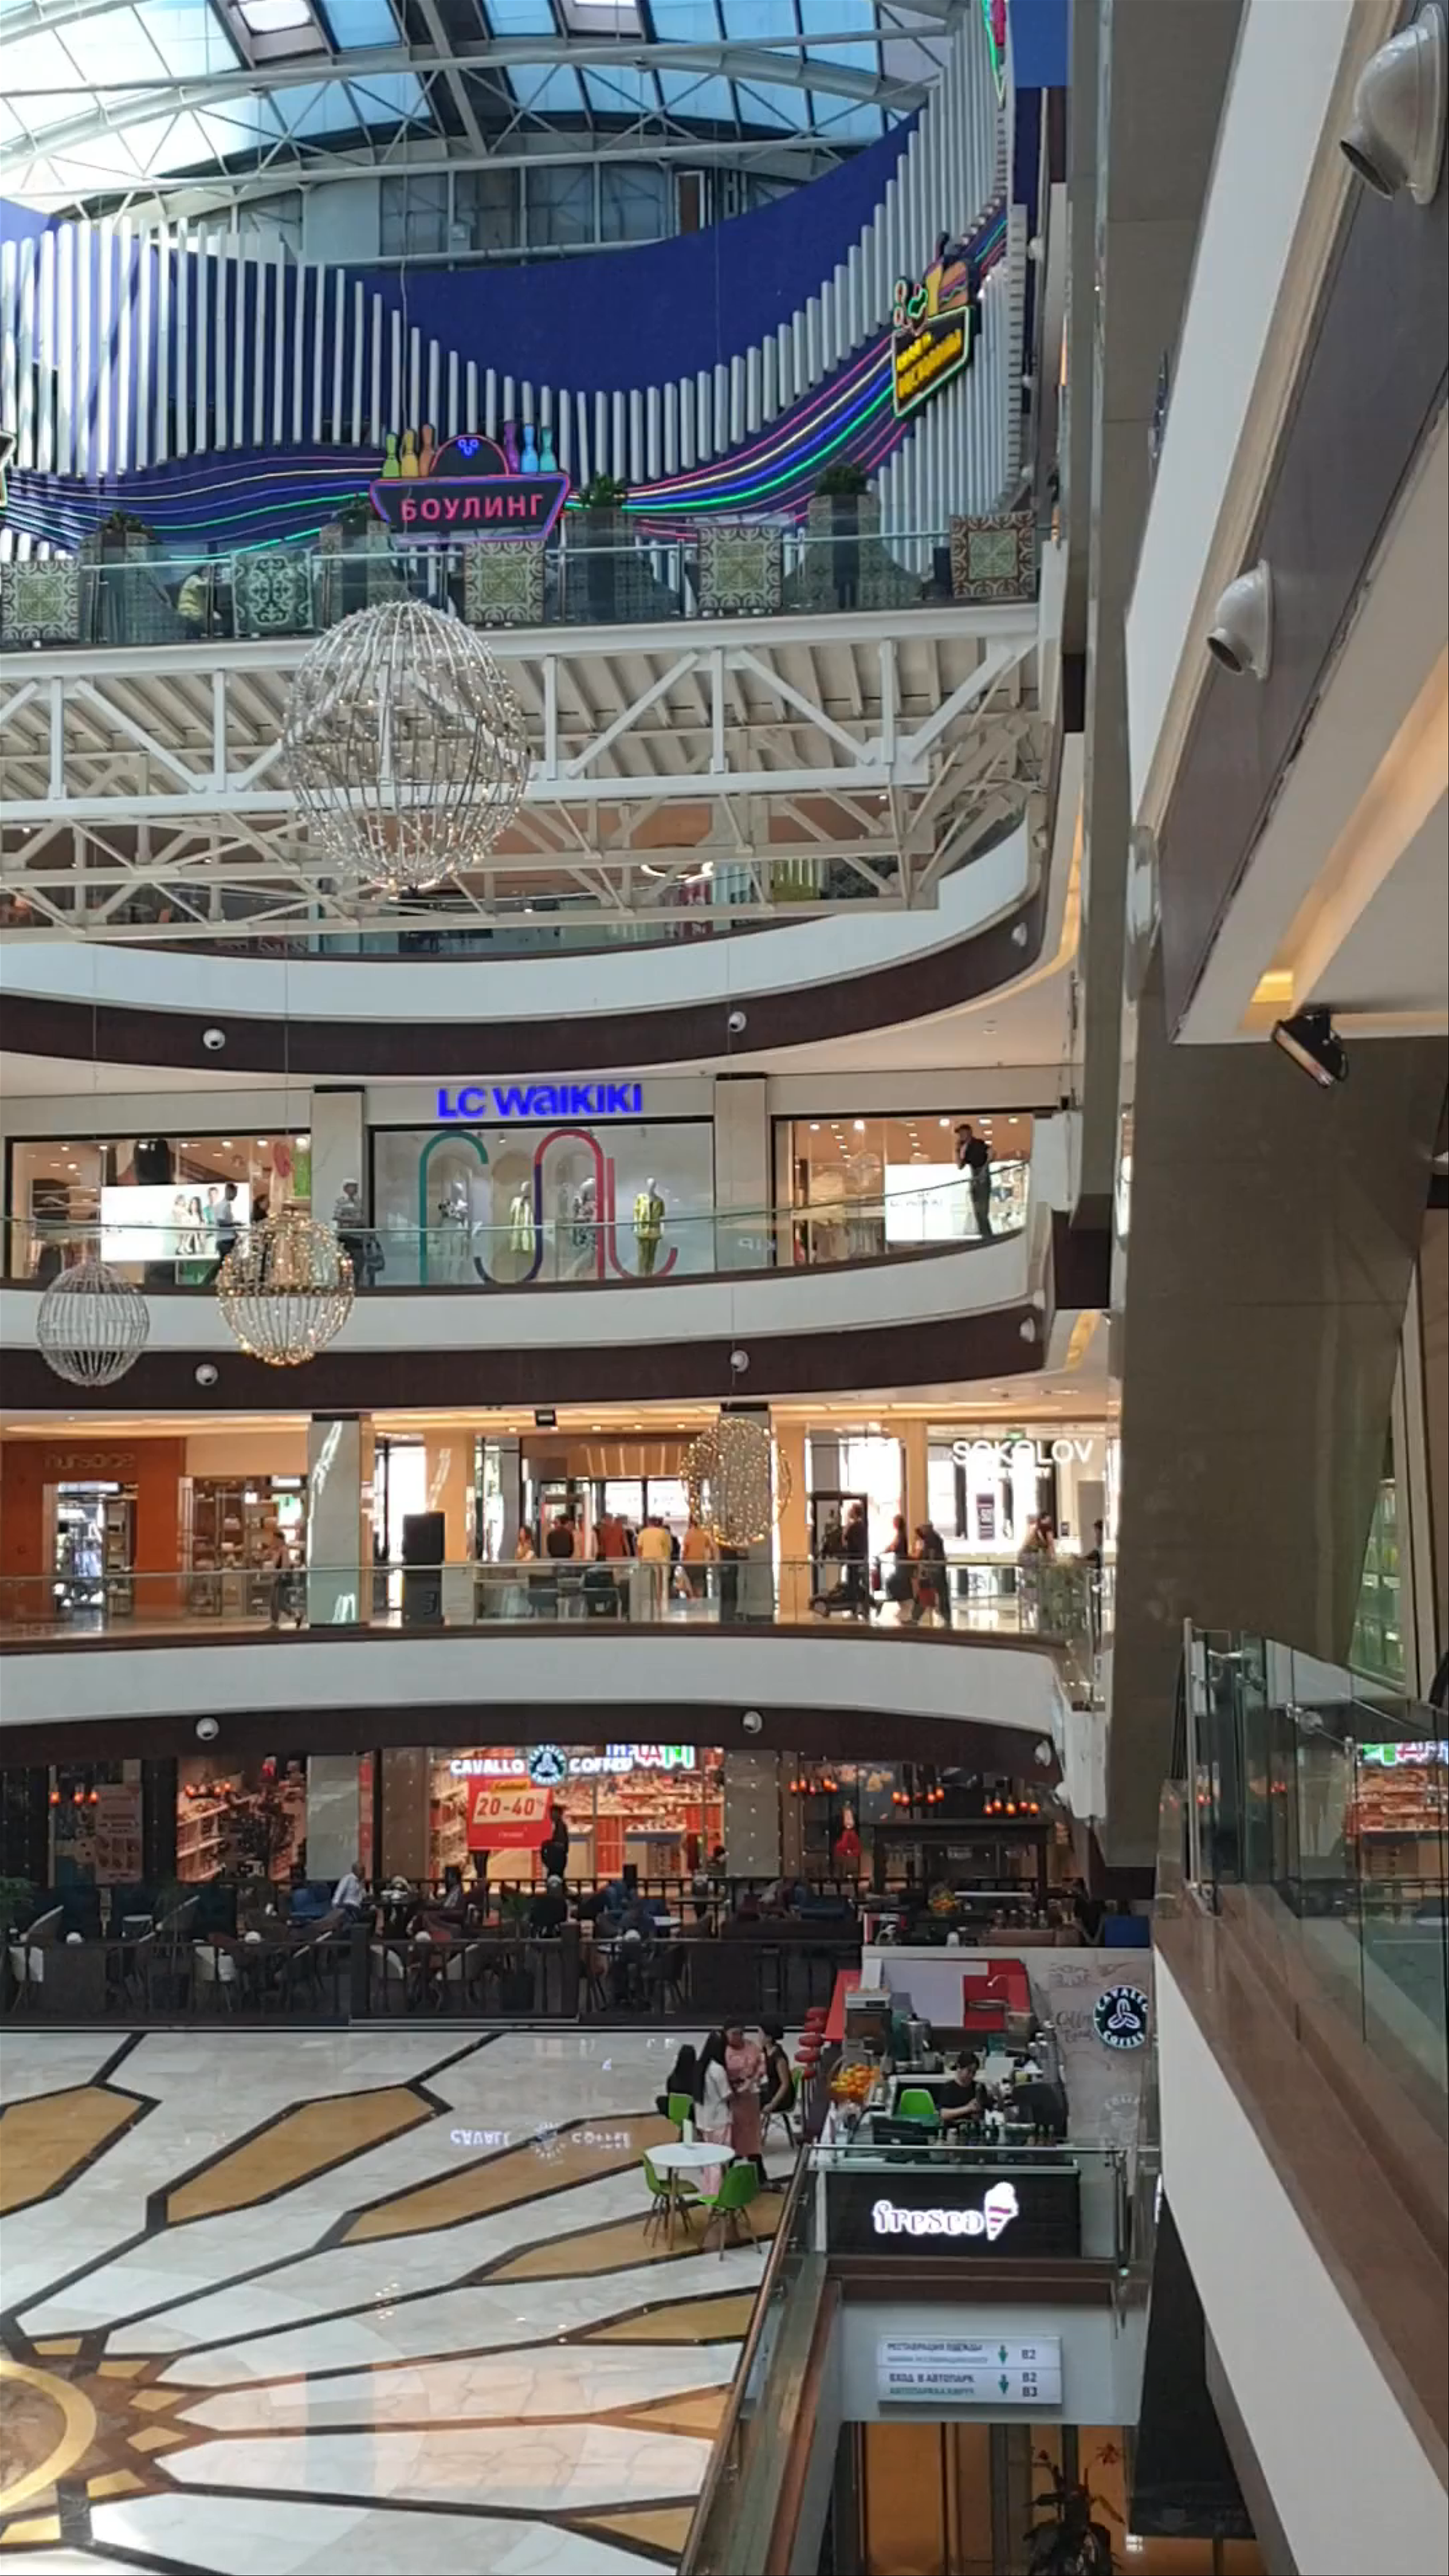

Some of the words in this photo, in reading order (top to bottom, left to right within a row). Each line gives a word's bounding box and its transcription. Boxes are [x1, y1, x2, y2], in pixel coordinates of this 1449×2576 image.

[401, 494, 543, 521] БОУЛИНГ
[438, 1087, 486, 1118] LC
[952, 1438, 1094, 1466] SOKOLOV
[450, 1759, 525, 1773] CAVALLO
[872, 2200, 985, 2235] fresco
